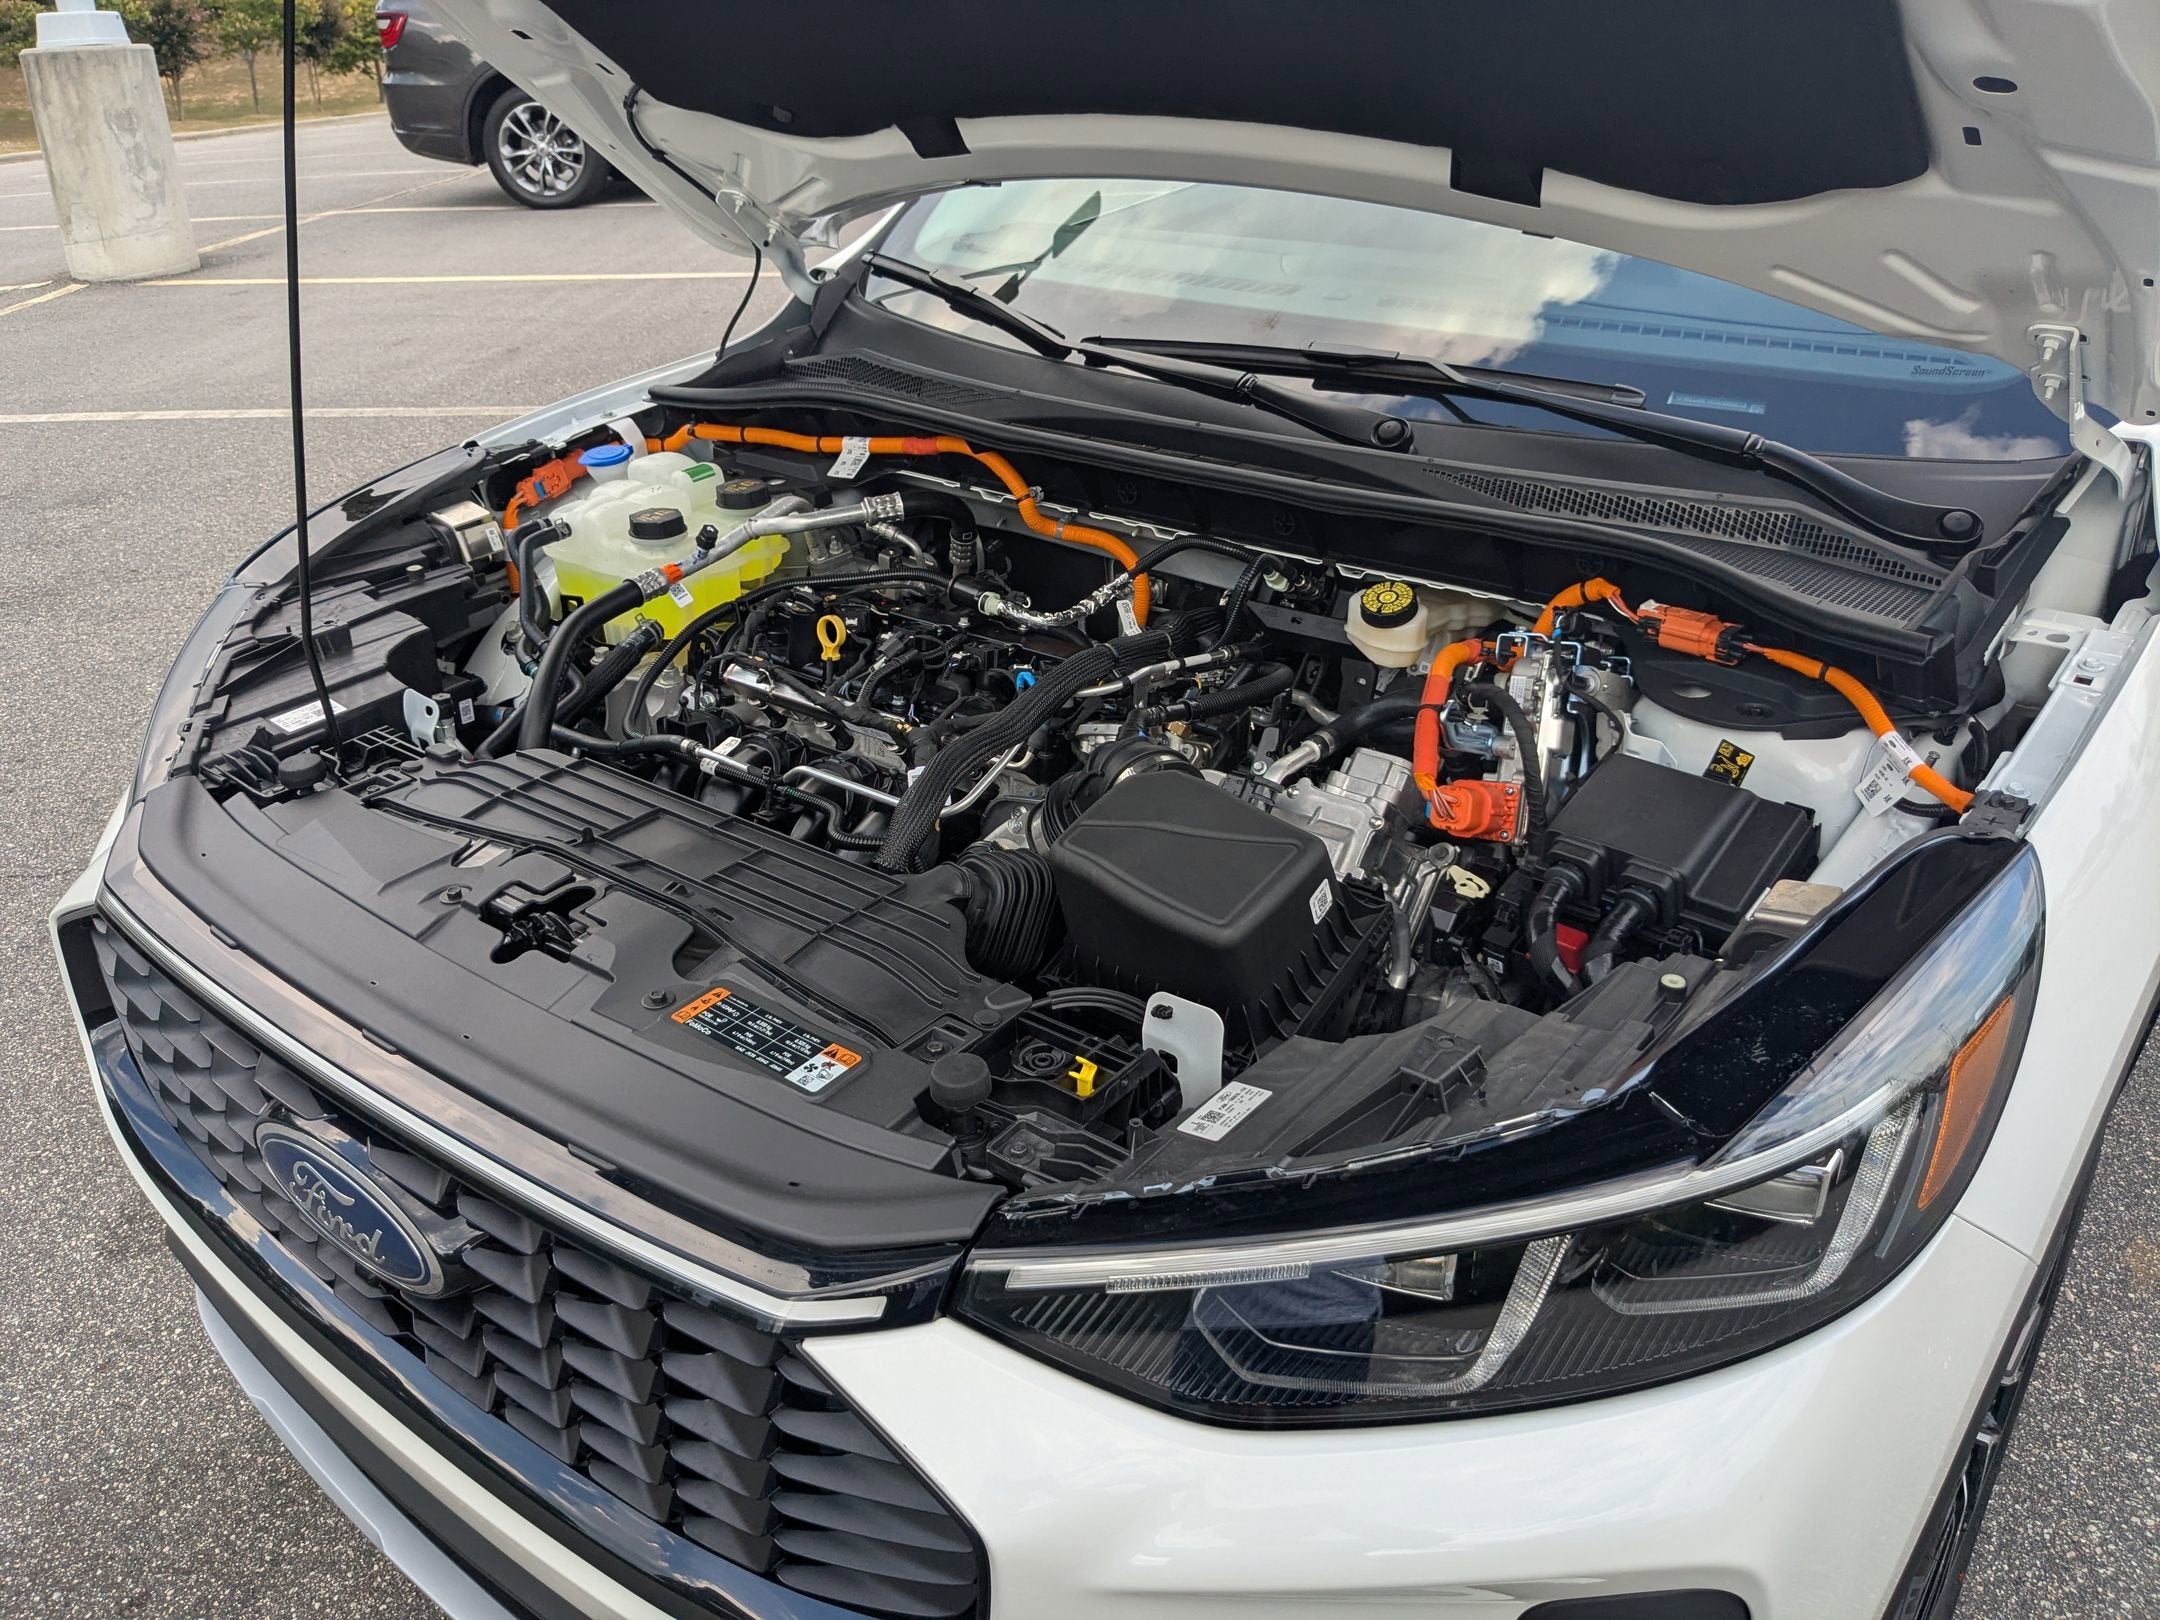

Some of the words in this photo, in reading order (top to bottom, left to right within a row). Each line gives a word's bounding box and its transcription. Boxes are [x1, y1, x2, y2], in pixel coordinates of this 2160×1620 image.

[1911, 365, 1986, 377] SoundScreen
[685, 1019, 711, 1035] FoMoCo
[289, 1160, 386, 1264] Ford
